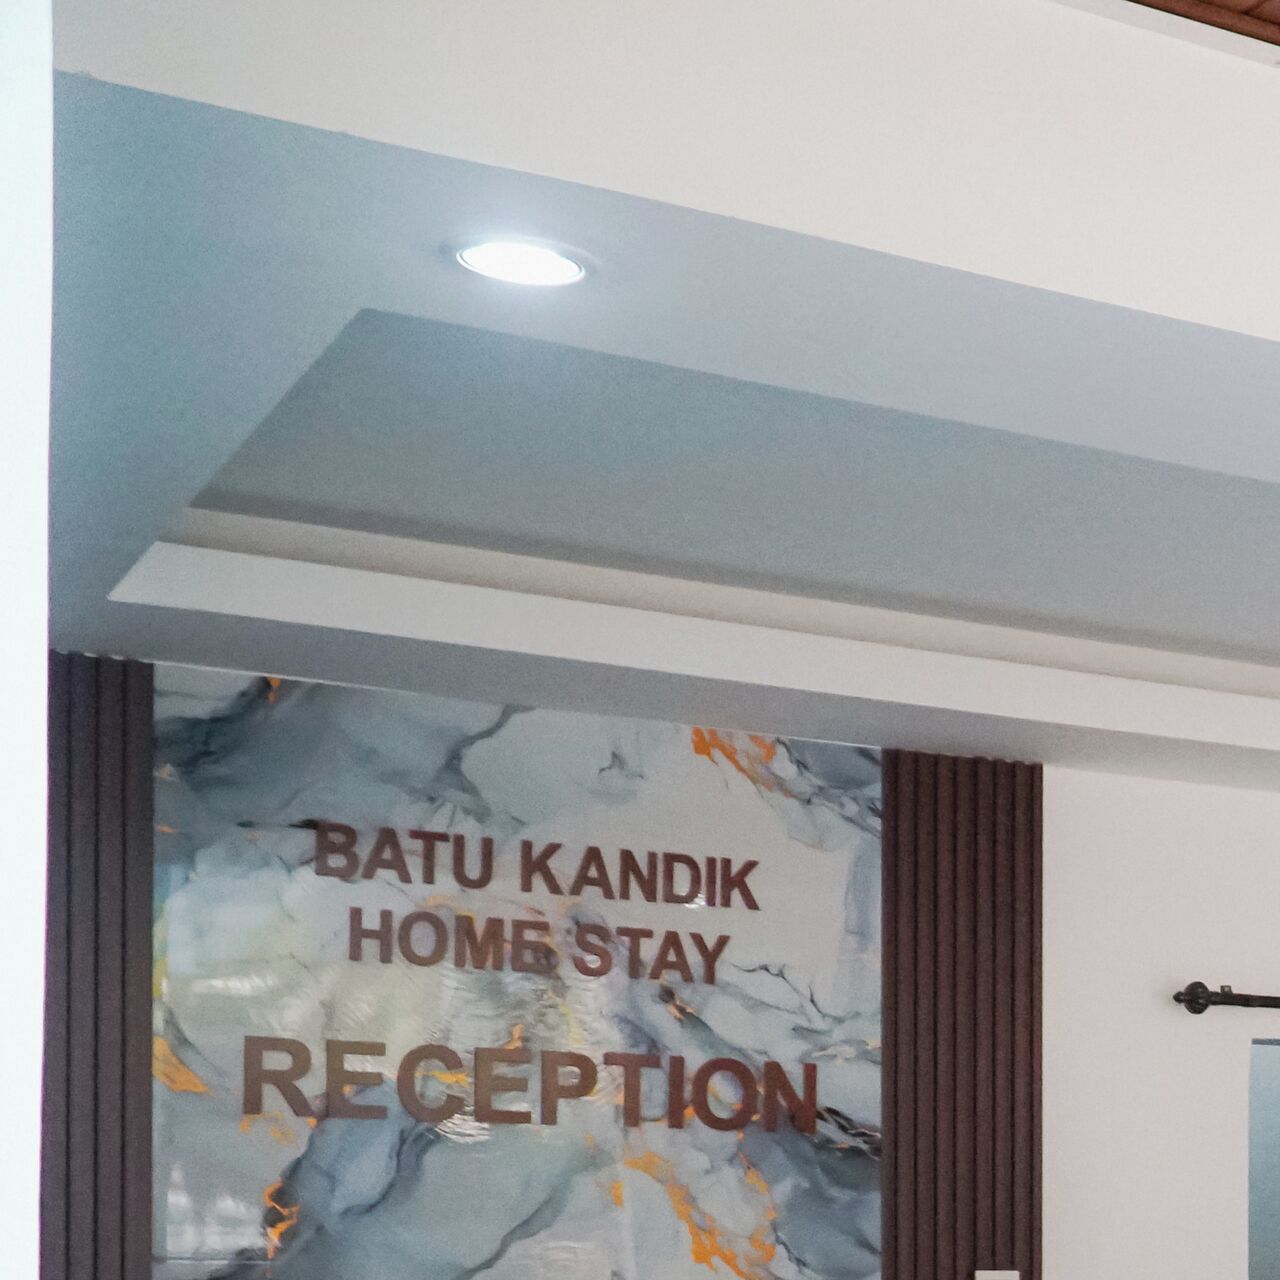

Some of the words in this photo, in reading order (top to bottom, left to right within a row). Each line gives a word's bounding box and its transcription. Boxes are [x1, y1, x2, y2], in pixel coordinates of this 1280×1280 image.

[313, 821, 494, 889] BATU
[519, 840, 762, 911] KANDIK
[348, 906, 554, 973] HOME
[573, 923, 731, 985] STAY
[242, 1034, 818, 1134] RECEPTION
